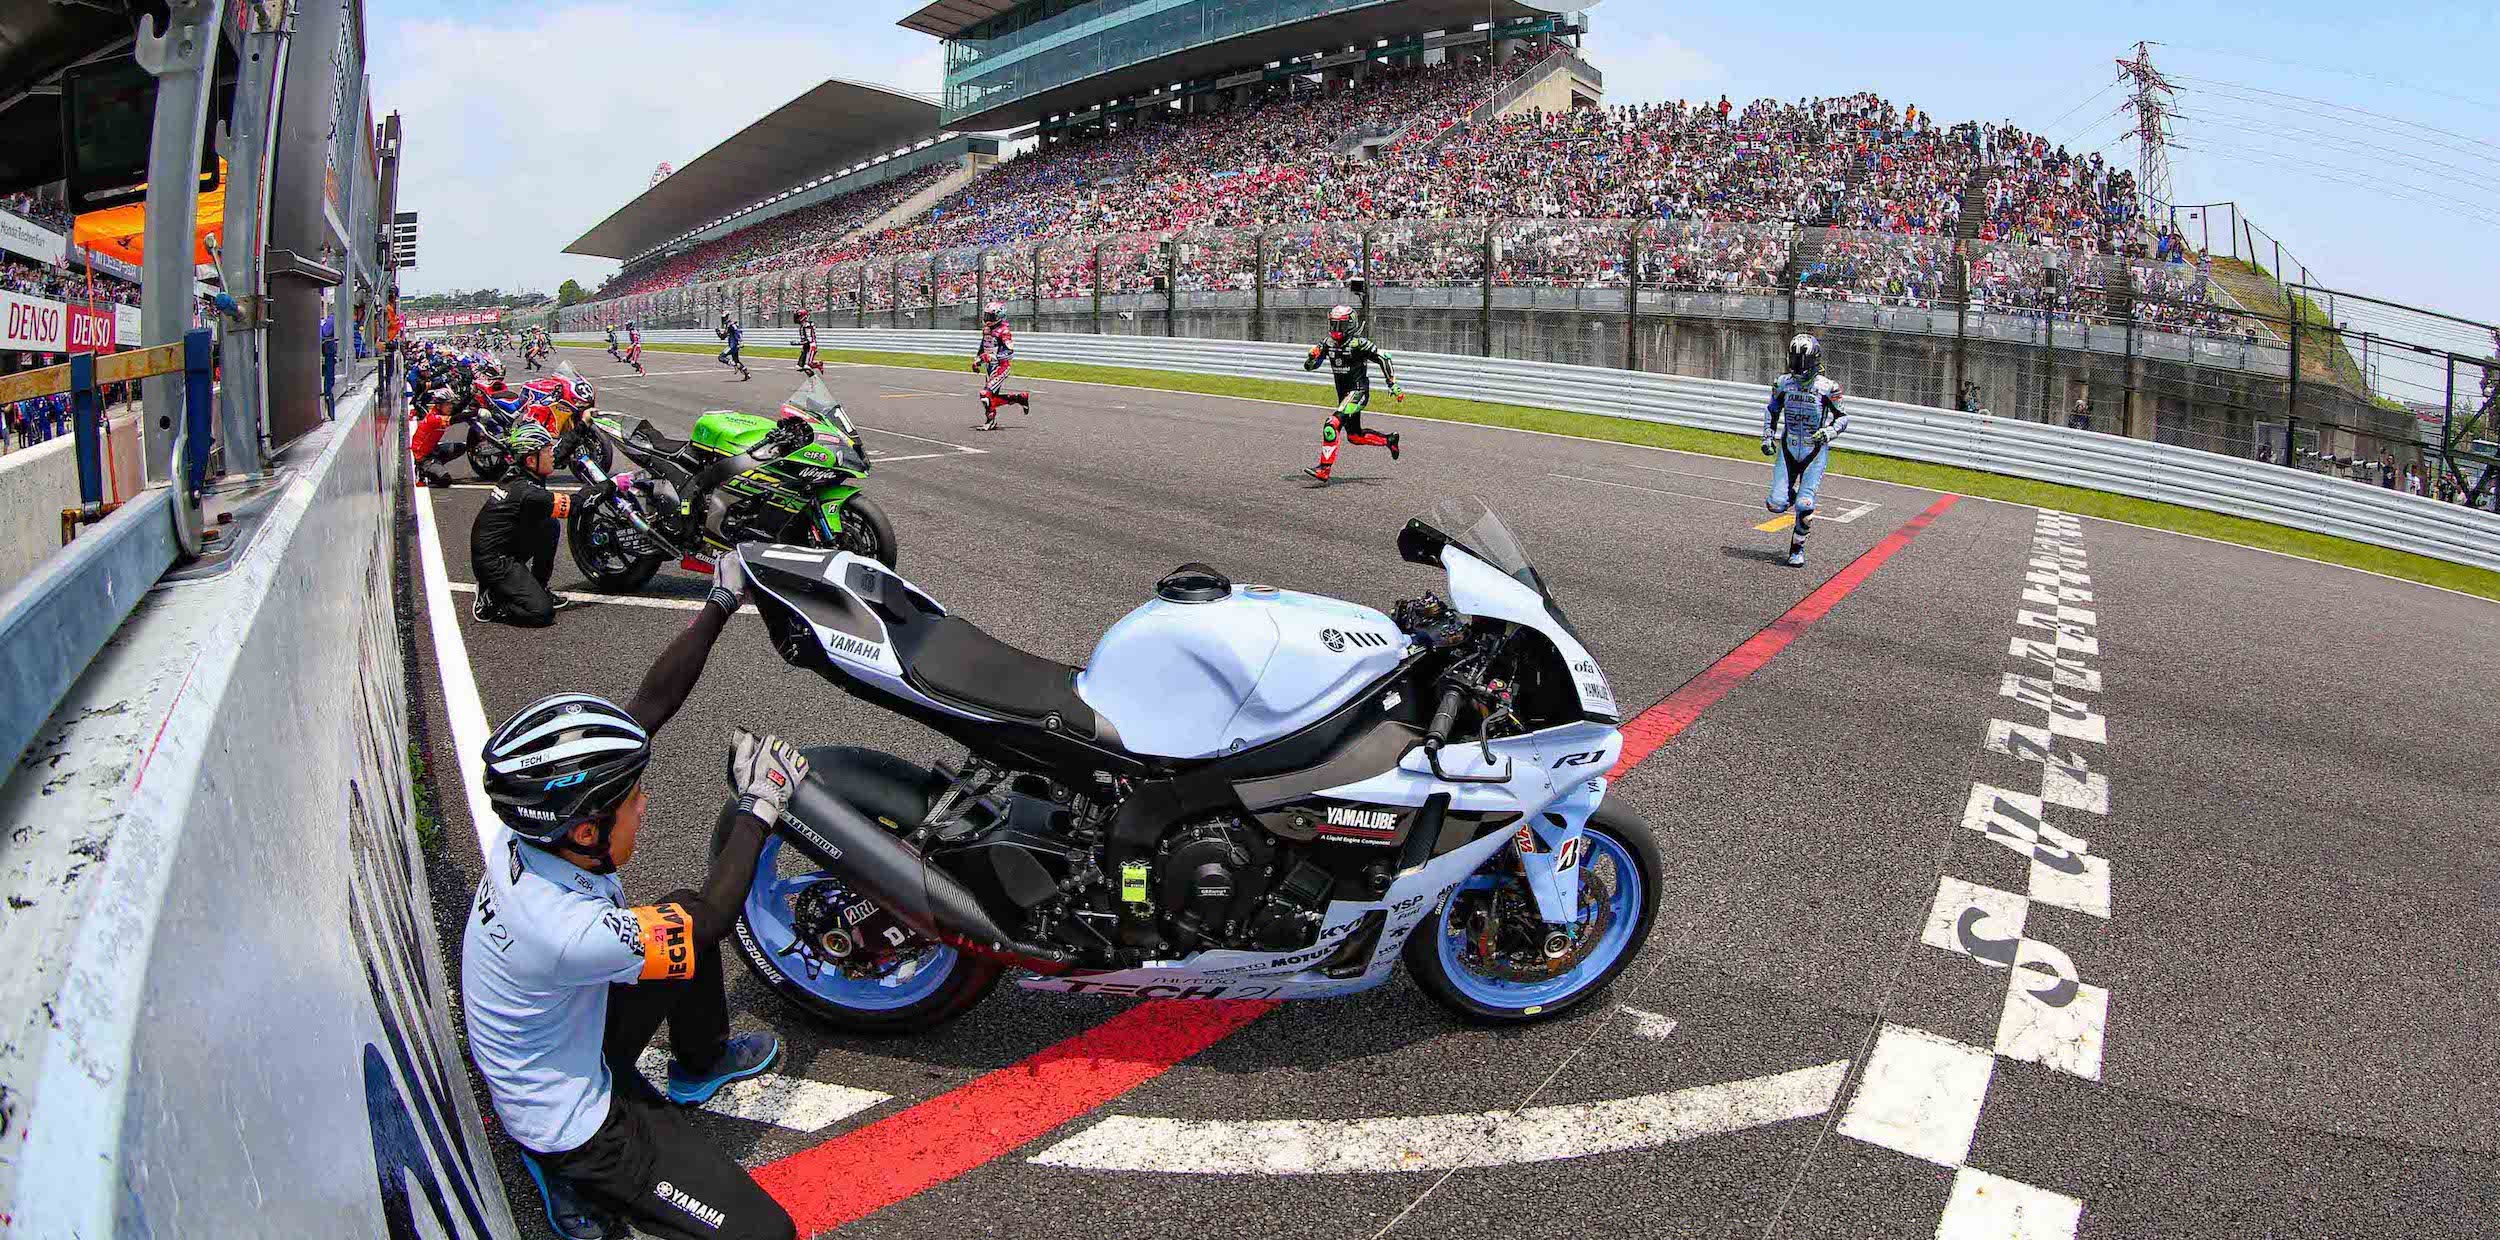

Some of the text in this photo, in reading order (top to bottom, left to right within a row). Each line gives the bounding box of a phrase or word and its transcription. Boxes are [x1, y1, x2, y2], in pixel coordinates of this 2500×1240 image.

[8, 302, 59, 343] DENSO
[73, 313, 111, 347] DENSO
[833, 408, 853, 433] 1
[799, 466, 837, 481] Ninja
[829, 633, 881, 661] YAMAHA
[1574, 660, 1595, 674] ofa
[520, 755, 542, 768] TECH
[1551, 749, 1605, 769] R1
[543, 770, 589, 791] R1
[517, 806, 557, 822] YAMAHA
[1326, 806, 1397, 831] YAMALUBE
[790, 817, 841, 858] TITANIUM
[1326, 834, 1343, 843] Liquid
[1343, 836, 1360, 844] Engine
[1361, 838, 1391, 846] Component
[574, 872, 594, 892] TECH
[1391, 894, 1424, 913] YSP
[655, 926, 664, 943] 21
[1271, 945, 1336, 968] MOTUL
[1061, 979, 1283, 1001] TECH 21
[671, 1188, 726, 1227] YAMAHA
